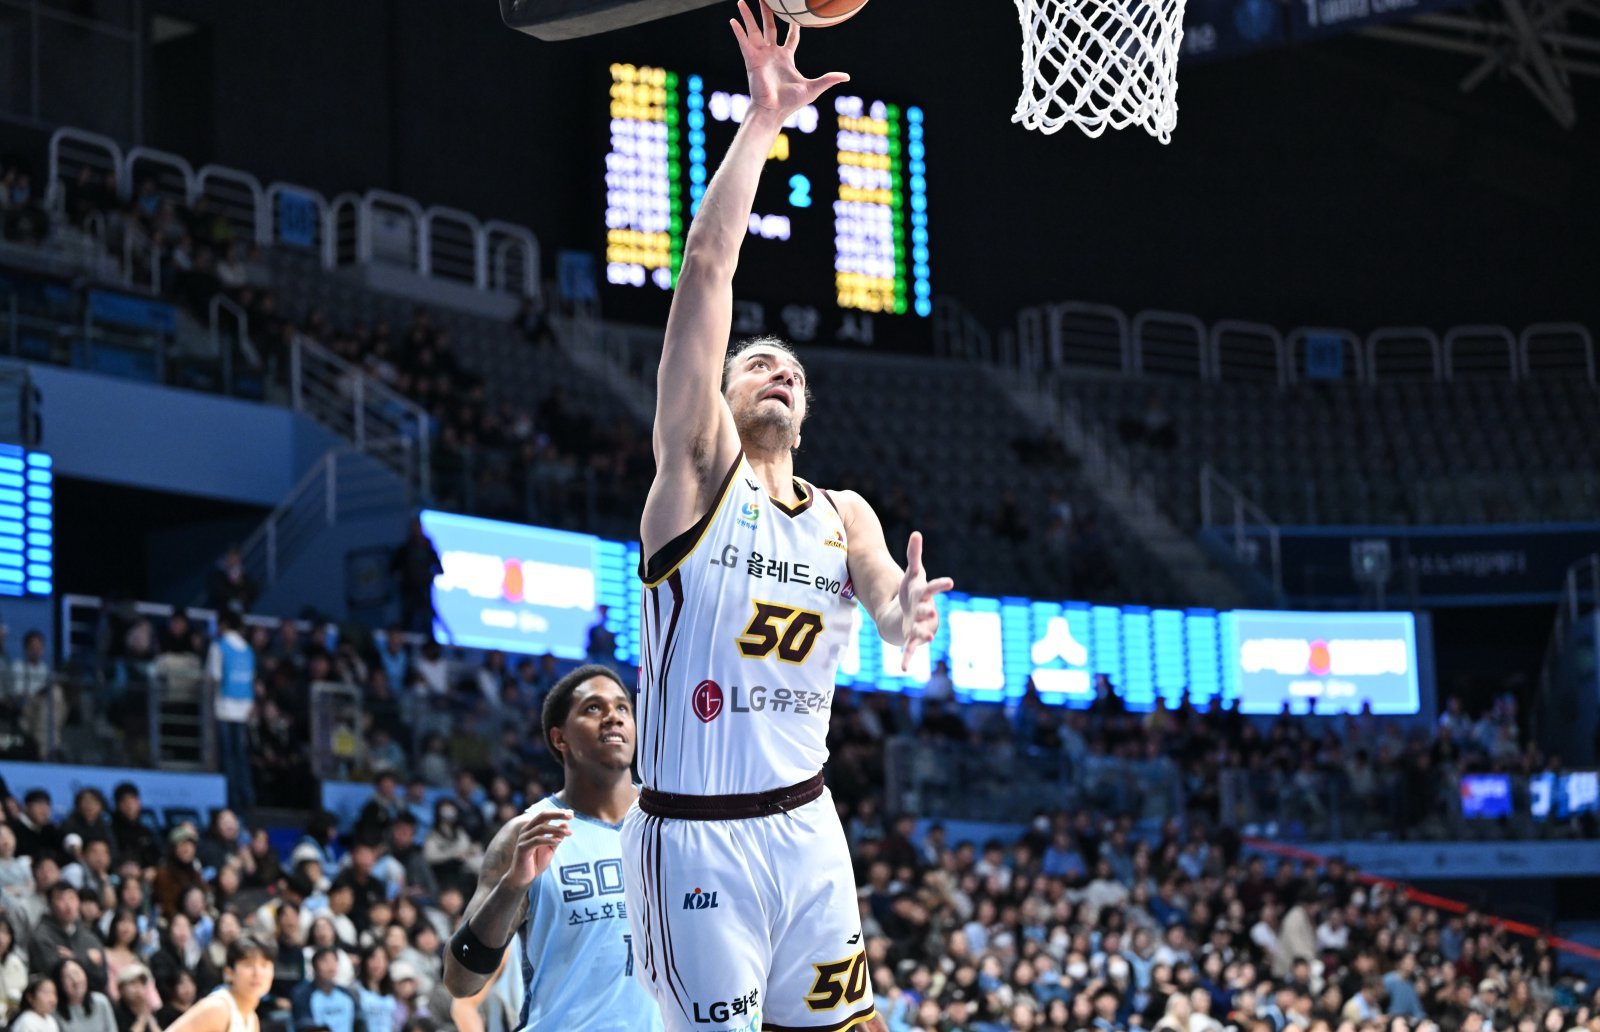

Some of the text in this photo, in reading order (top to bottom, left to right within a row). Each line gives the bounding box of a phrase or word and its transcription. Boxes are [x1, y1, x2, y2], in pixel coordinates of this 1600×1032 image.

[789, 174, 811, 207] 2
[747, 551, 811, 585] 올레드
[815, 576, 840, 594] evo
[735, 598, 825, 666] 50
[683, 889, 718, 909] KBL
[803, 950, 867, 1012] 50
